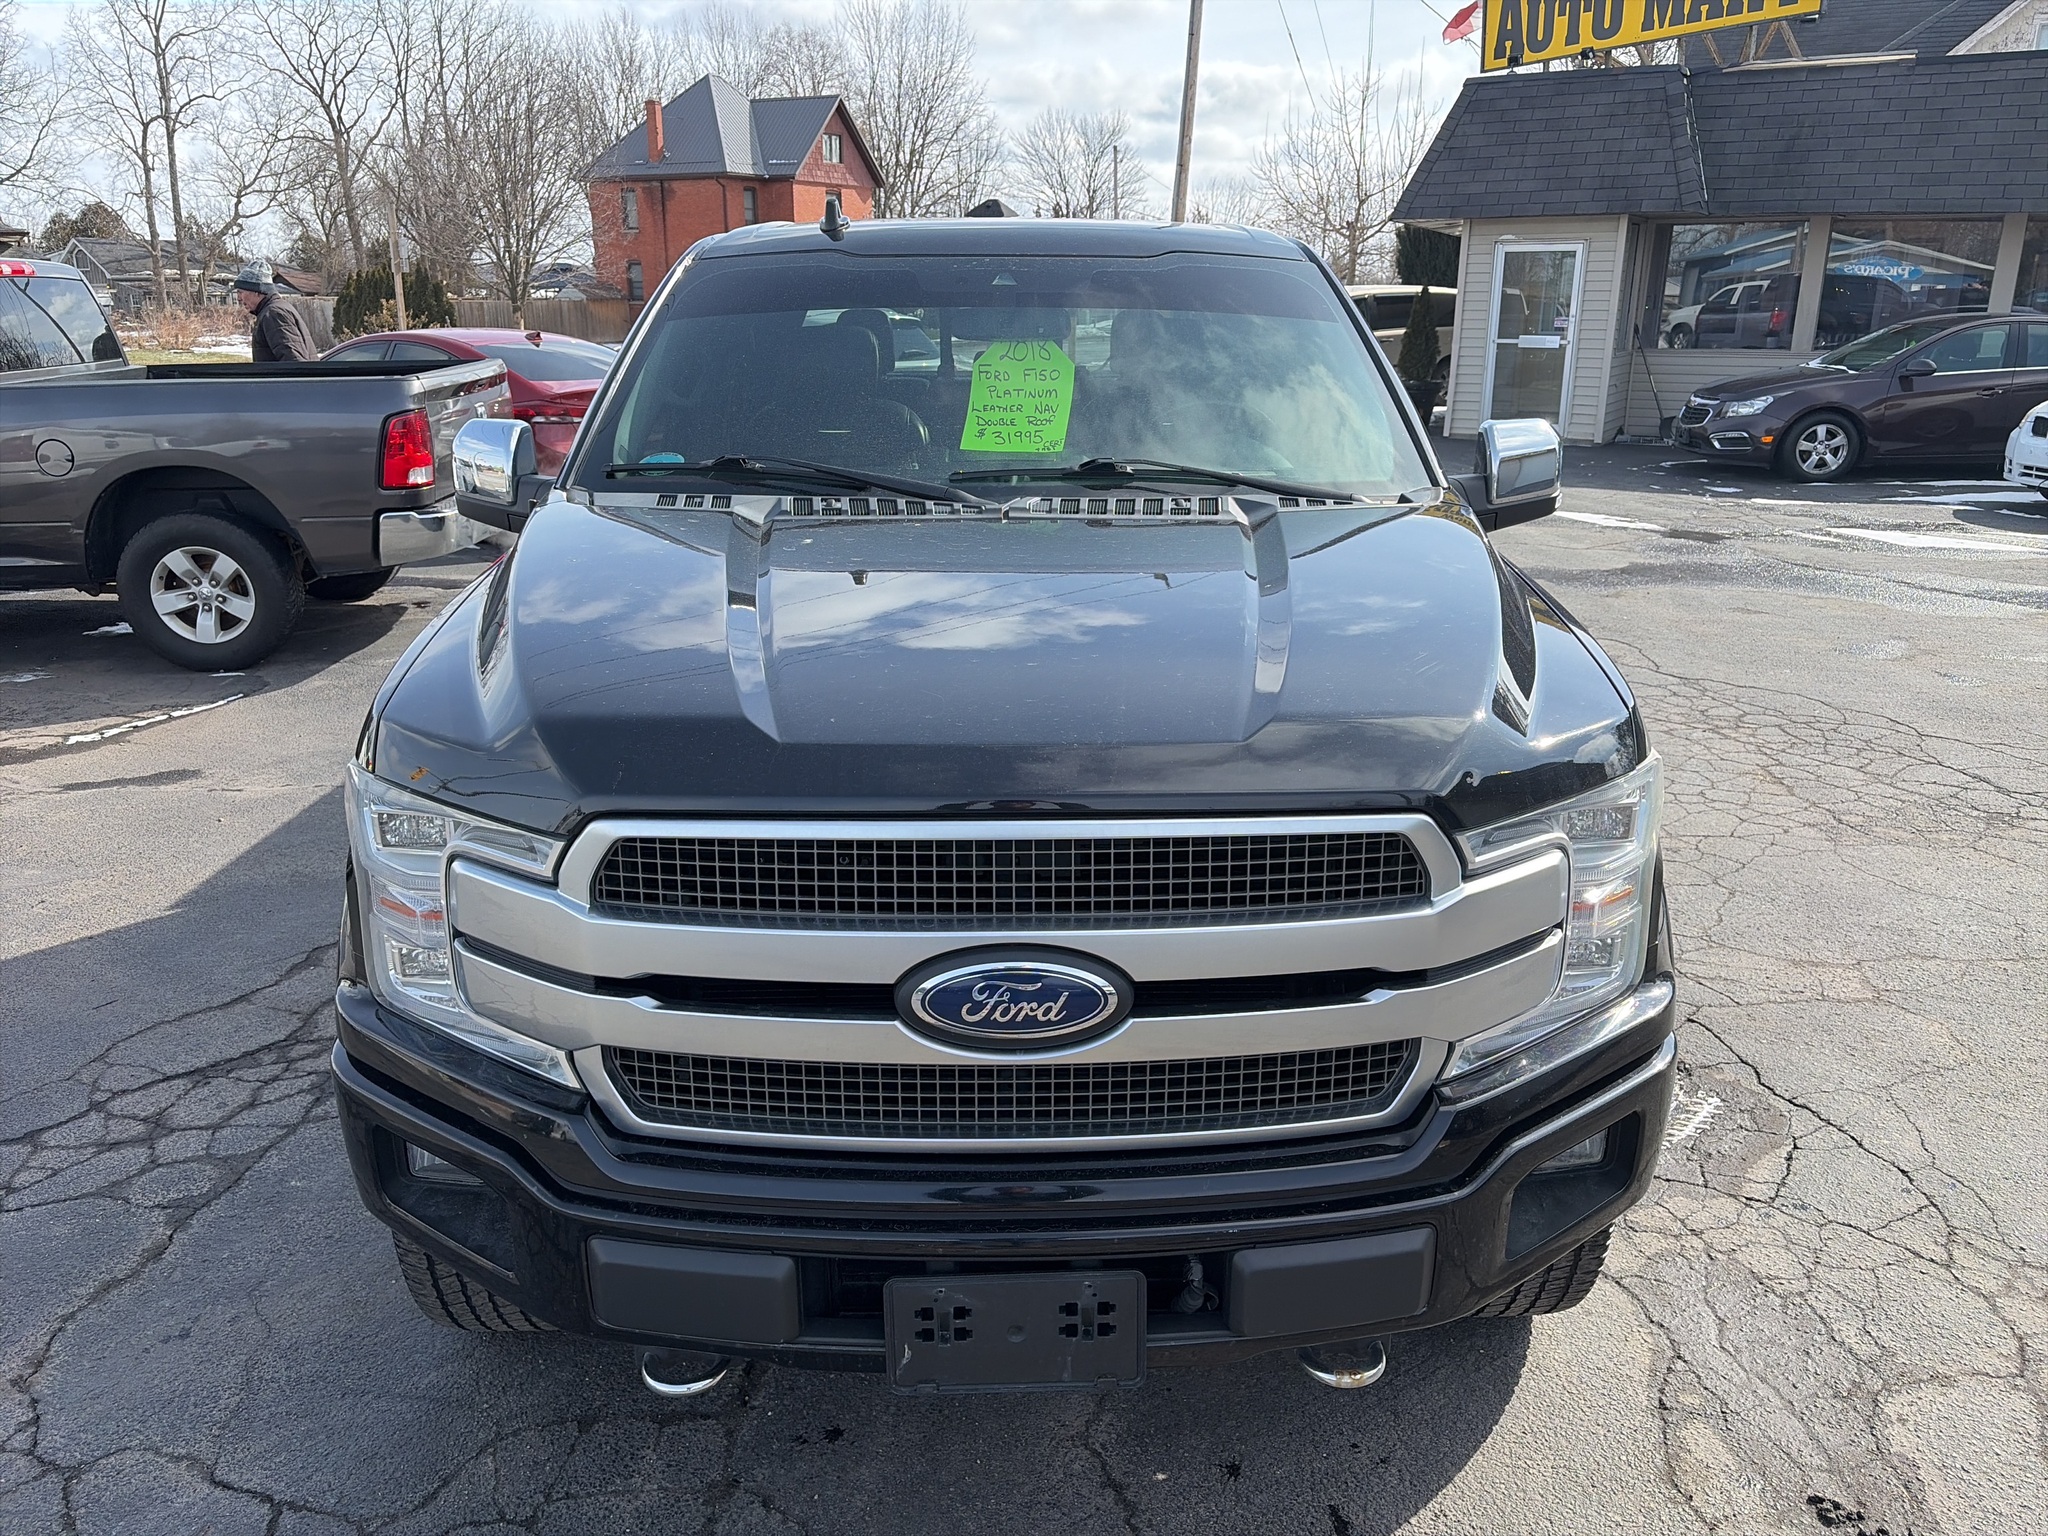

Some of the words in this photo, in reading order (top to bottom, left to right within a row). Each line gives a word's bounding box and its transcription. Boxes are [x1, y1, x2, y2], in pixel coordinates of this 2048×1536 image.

[1493, 0, 1623, 60] AUTO
[999, 340, 1052, 362] 2018
[977, 363, 1011, 382] FORD
[1023, 367, 1061, 382] F150
[986, 385, 1058, 399] PLATINUM
[971, 401, 1024, 413] LEATHER
[1034, 401, 1060, 415] NAV
[975, 415, 1018, 427] DOUBLE
[991, 430, 1045, 445] 31995
[960, 980, 1070, 1022] Ford
